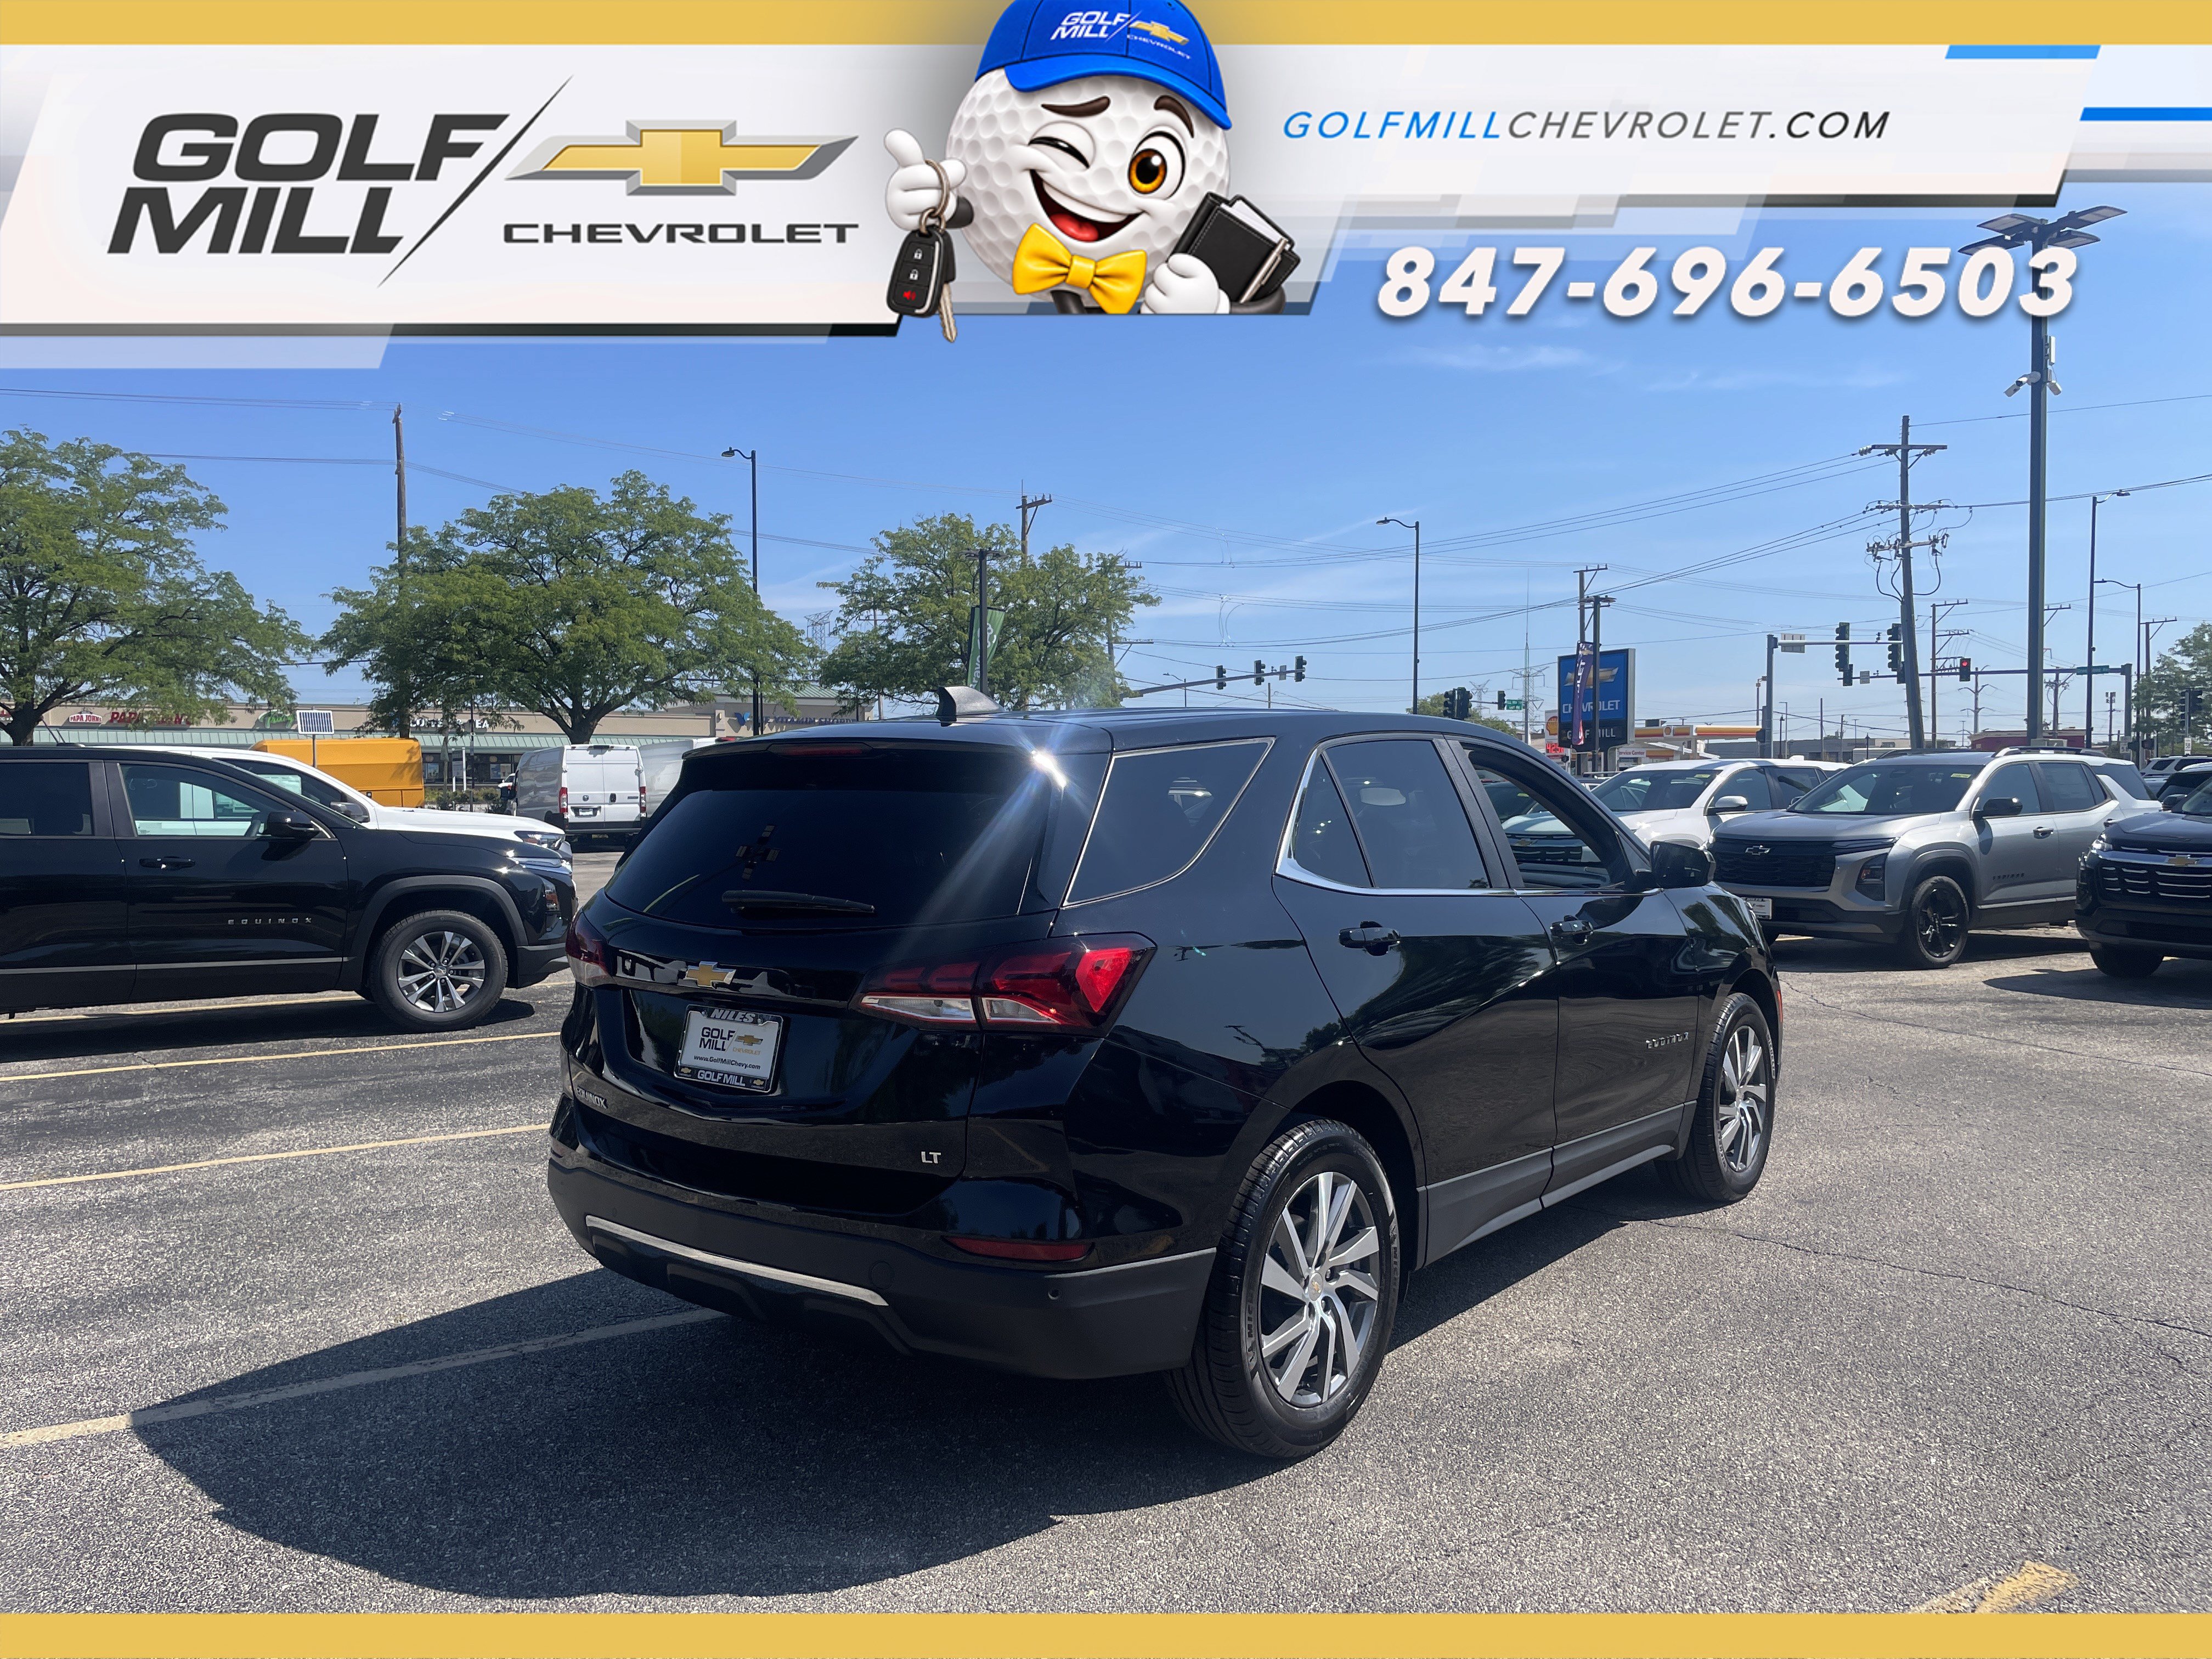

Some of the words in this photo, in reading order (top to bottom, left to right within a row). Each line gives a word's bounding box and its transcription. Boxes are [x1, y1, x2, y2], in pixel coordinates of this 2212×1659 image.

[1598, 728, 1616, 738] ILL
[710, 1009, 756, 1023] NILES
[701, 1026, 736, 1041] GOLF
[1645, 1032, 1689, 1049] EQUINOX
[699, 1037, 727, 1052] MILL
[693, 1055, 761, 1070] www.GolfMillChevy.com
[921, 1151, 941, 1164] LT
